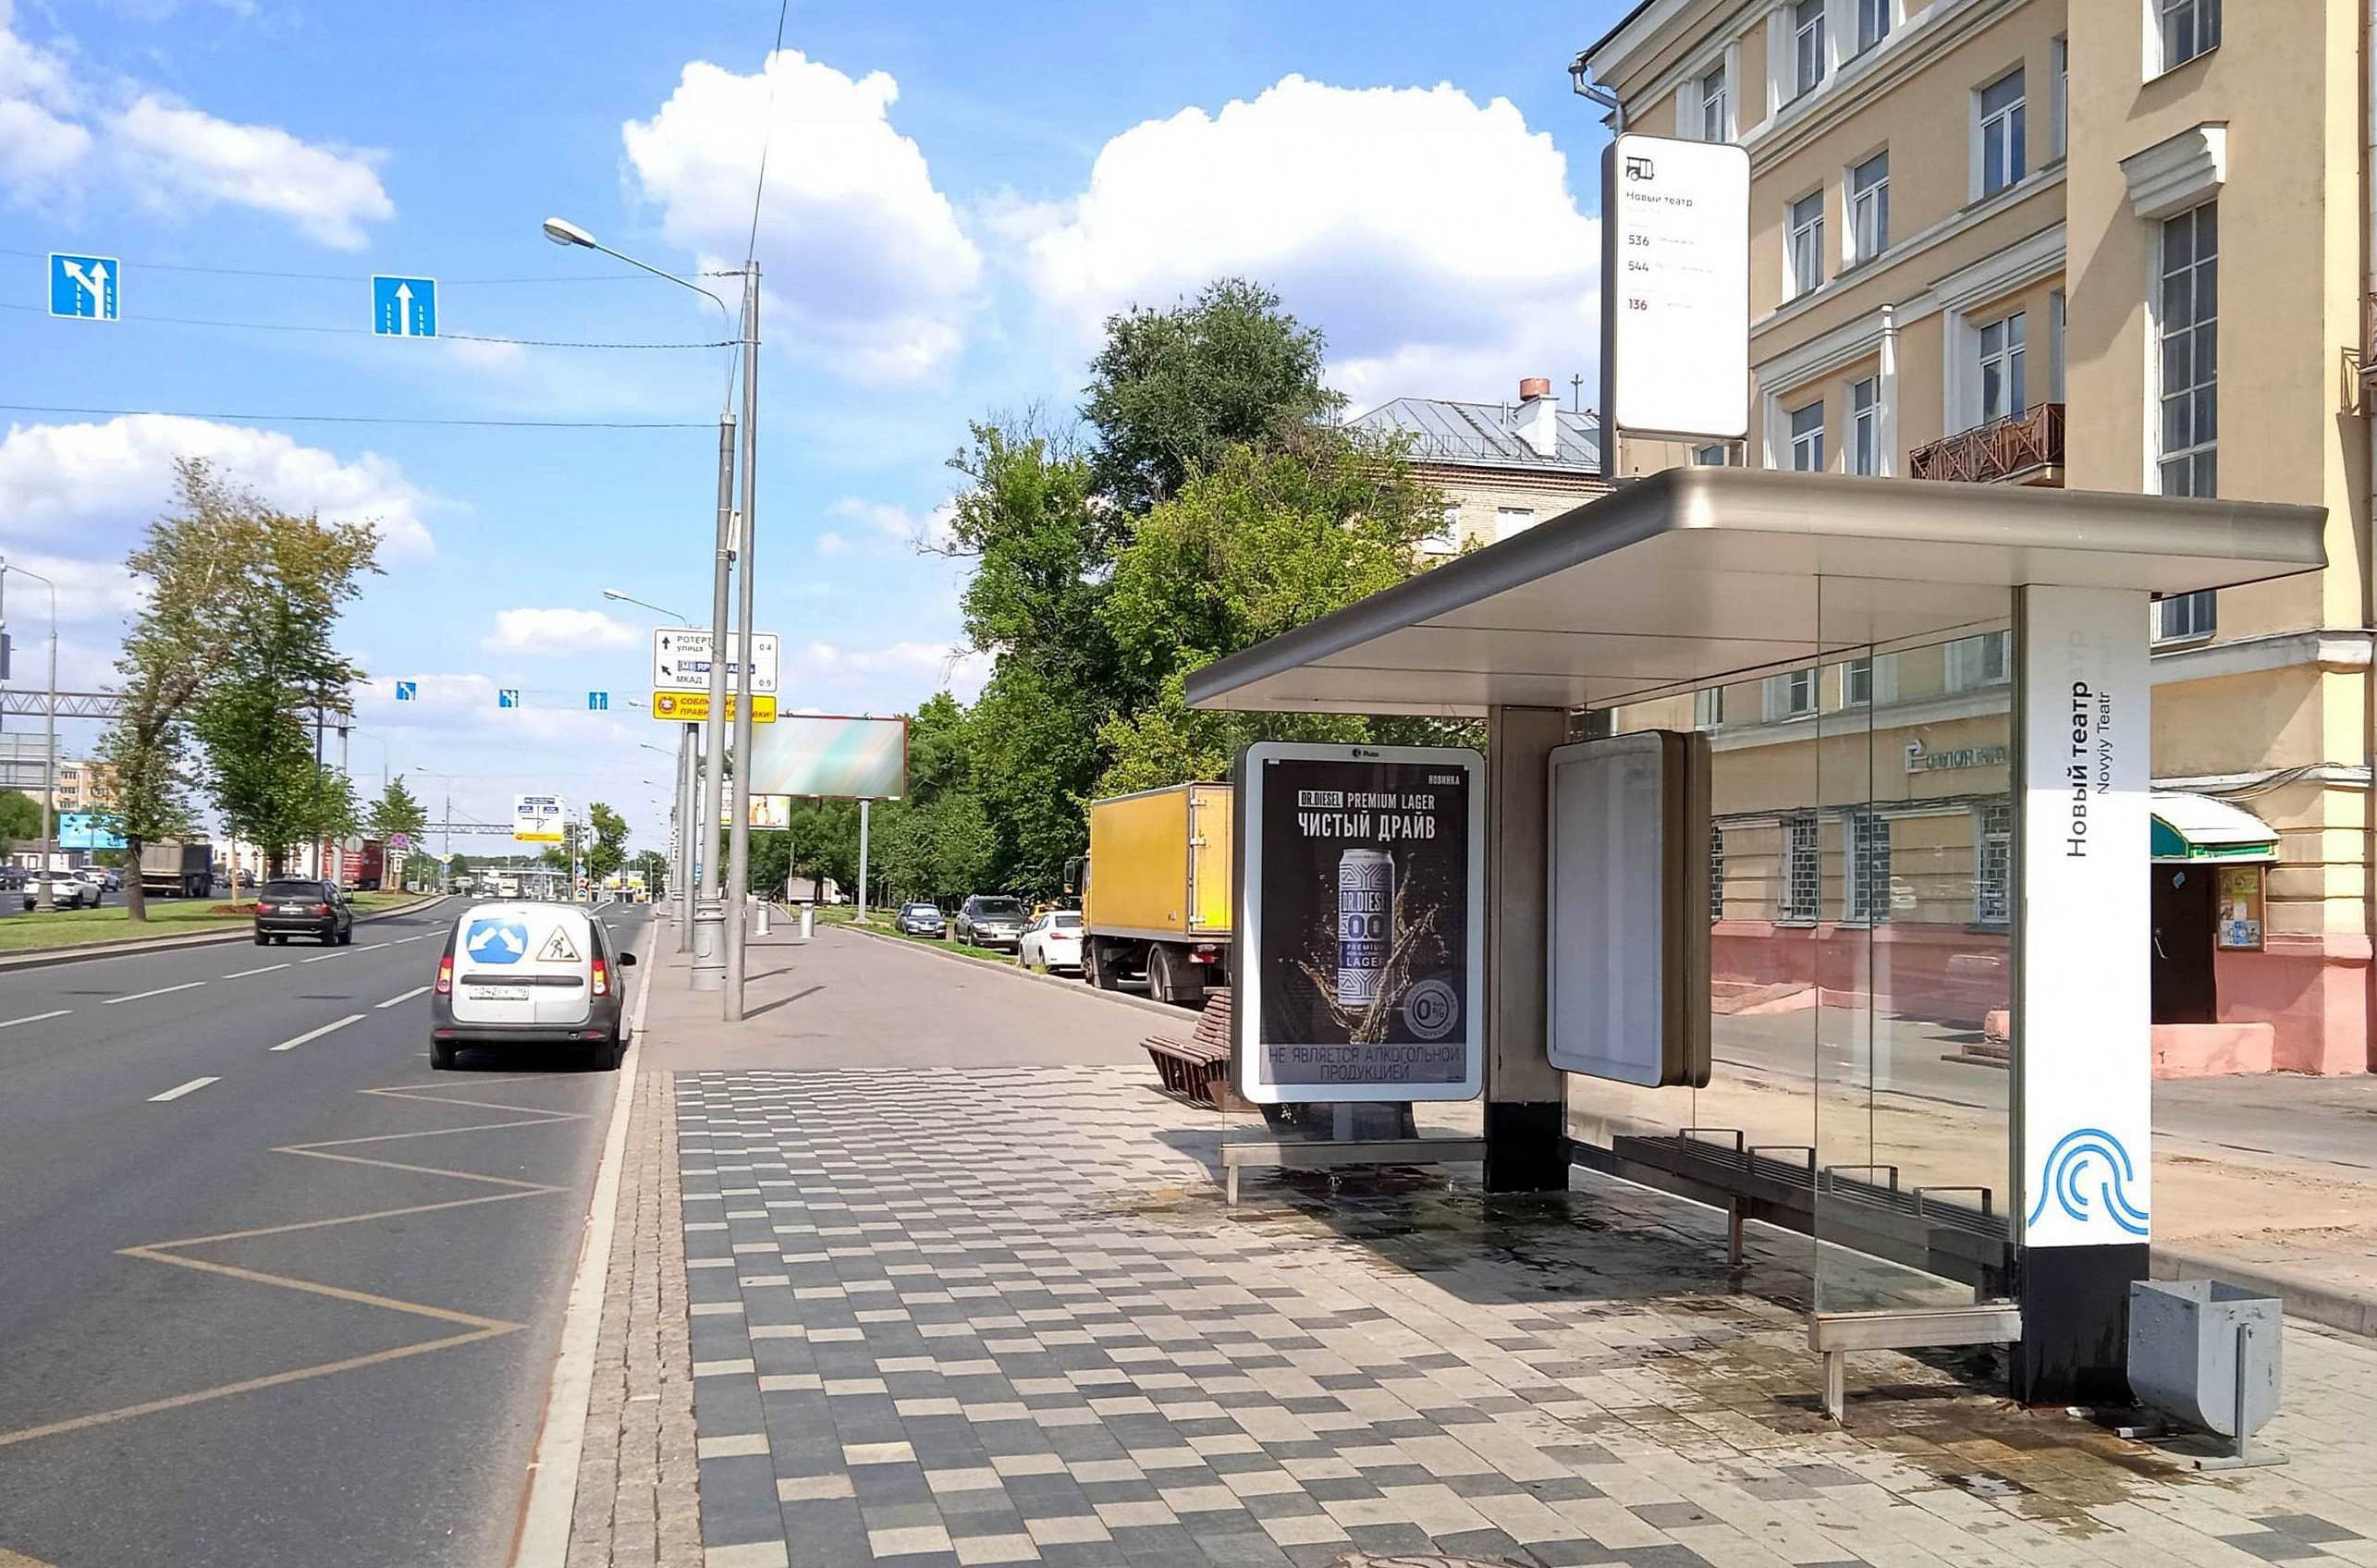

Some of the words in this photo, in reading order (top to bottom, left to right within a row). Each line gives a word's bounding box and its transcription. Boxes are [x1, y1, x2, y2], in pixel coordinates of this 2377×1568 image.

[1628, 234, 1649, 247] 536
[1628, 260, 1649, 272] 544
[1628, 298, 1648, 311] 136
[676, 675, 703, 684] МКАД
[2072, 680, 2093, 758] театр
[2096, 691, 2111, 735] Teatr
[2096, 739, 2114, 794] Novyiy
[1428, 774, 1460, 785] НОВИНКА
[1300, 790, 1342, 807] DR.DIESEL
[1347, 792, 1397, 809] PREMIUM
[1402, 794, 1435, 810] LAGER
[2066, 766, 2089, 858] Новый
[1298, 809, 1370, 838] ЧИСТЫЙ
[1378, 811, 1435, 841] ДРАЙВ
[1269, 1047, 1286, 1063] НЕ
[1293, 1047, 1359, 1064] ЯВЛЯЕТСЯ
[1365, 1047, 1461, 1064] АЛКОГОЛЬНОЙ
[1320, 1064, 1410, 1081] ПРОДУКЦИЕЙ
